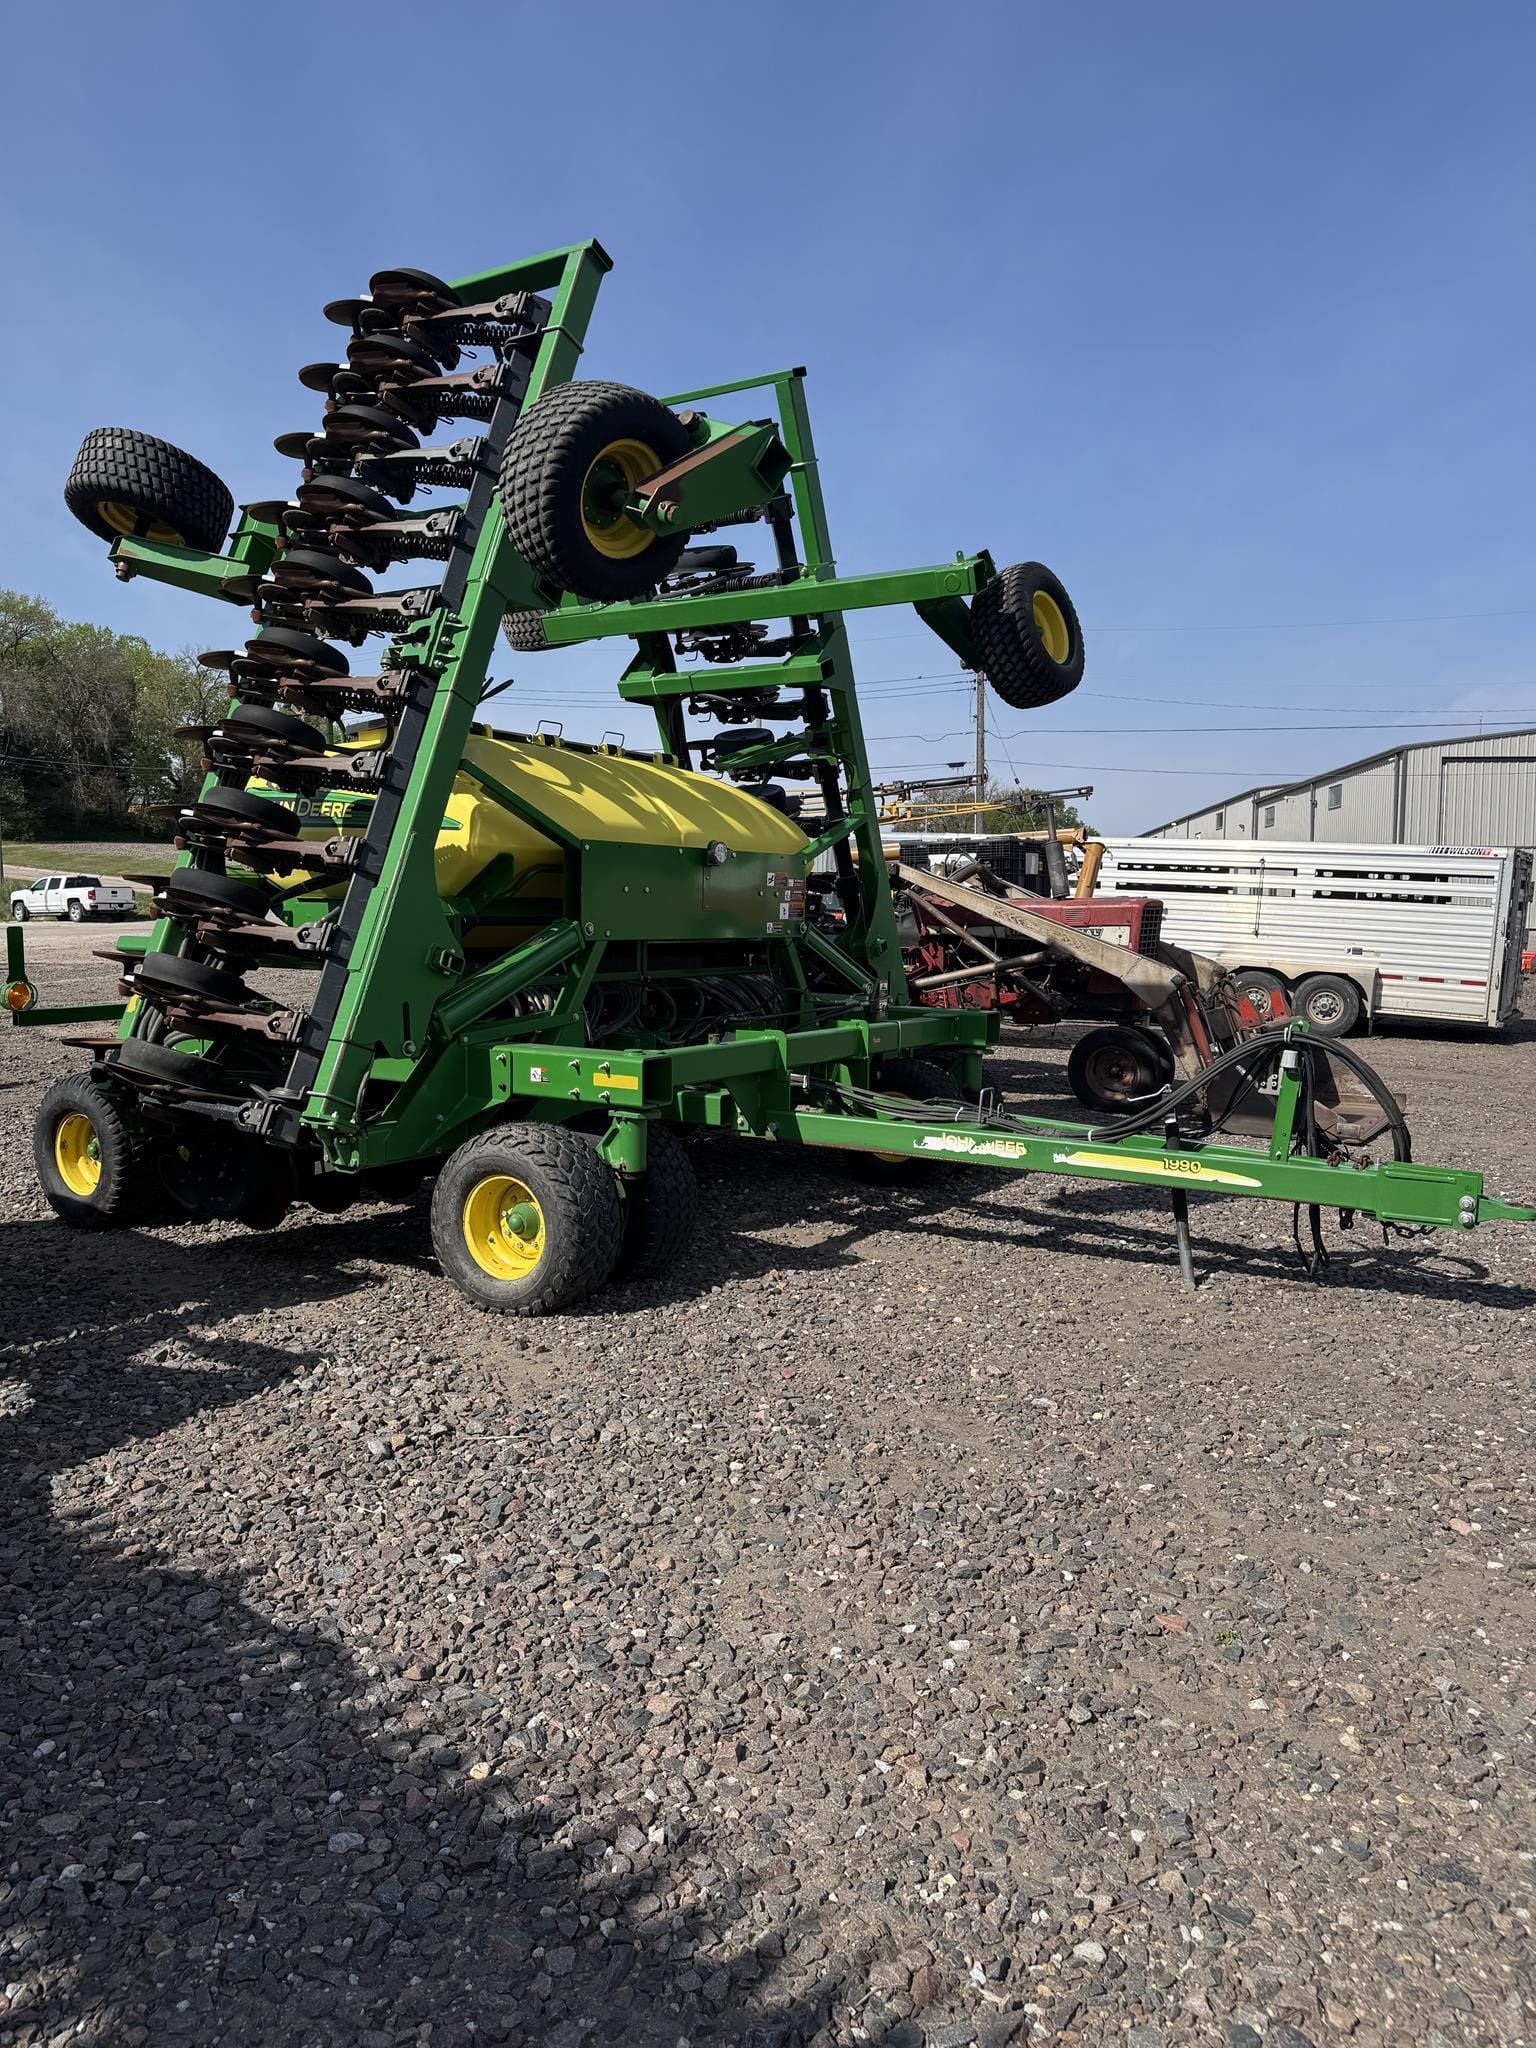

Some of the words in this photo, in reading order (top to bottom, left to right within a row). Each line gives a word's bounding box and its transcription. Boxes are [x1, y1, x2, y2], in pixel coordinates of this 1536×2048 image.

[296, 798, 355, 818] DEERE
[1449, 847, 1483, 856] WILSON
[1163, 1157, 1202, 1174] 1990
